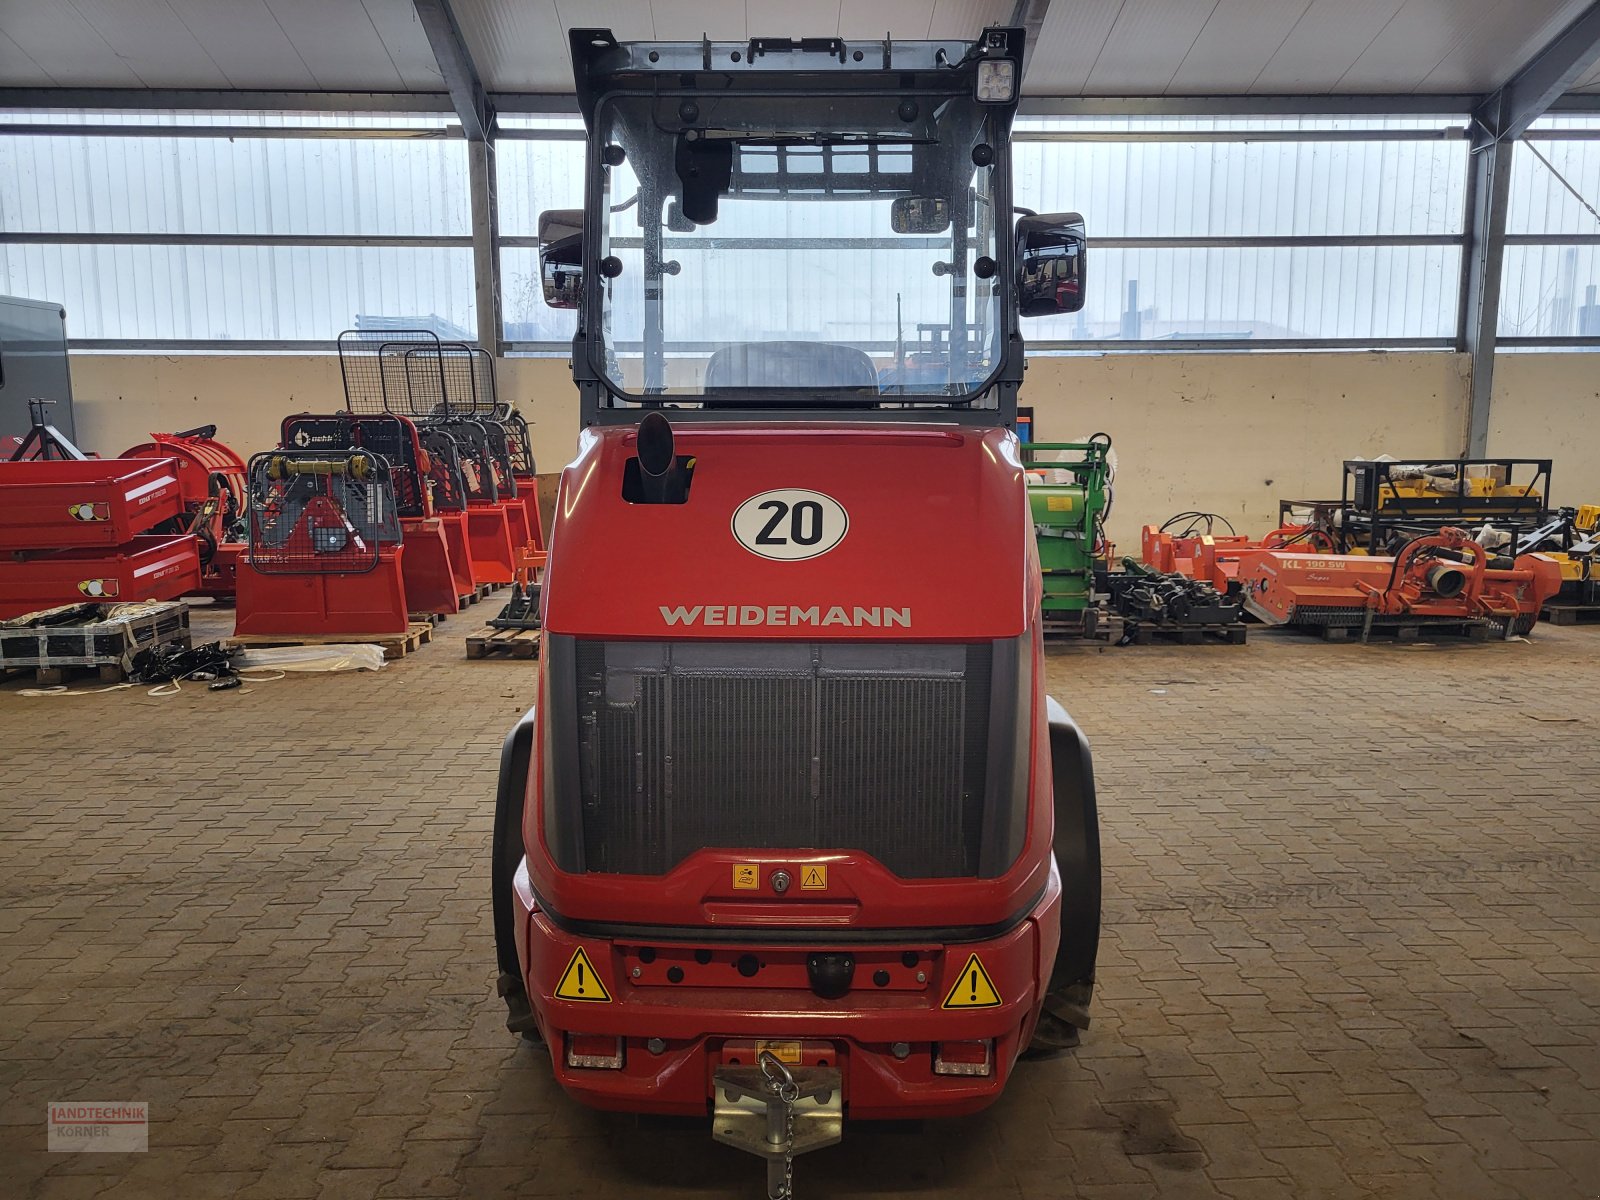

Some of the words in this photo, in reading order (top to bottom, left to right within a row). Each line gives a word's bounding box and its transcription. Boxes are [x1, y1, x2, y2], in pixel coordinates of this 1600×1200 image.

[755, 500, 823, 546] 20
[1282, 560, 1302, 569] KL
[1306, 561, 1326, 569] 190
[1328, 561, 1345, 569] SW
[658, 605, 912, 628] WEIDEMANN
